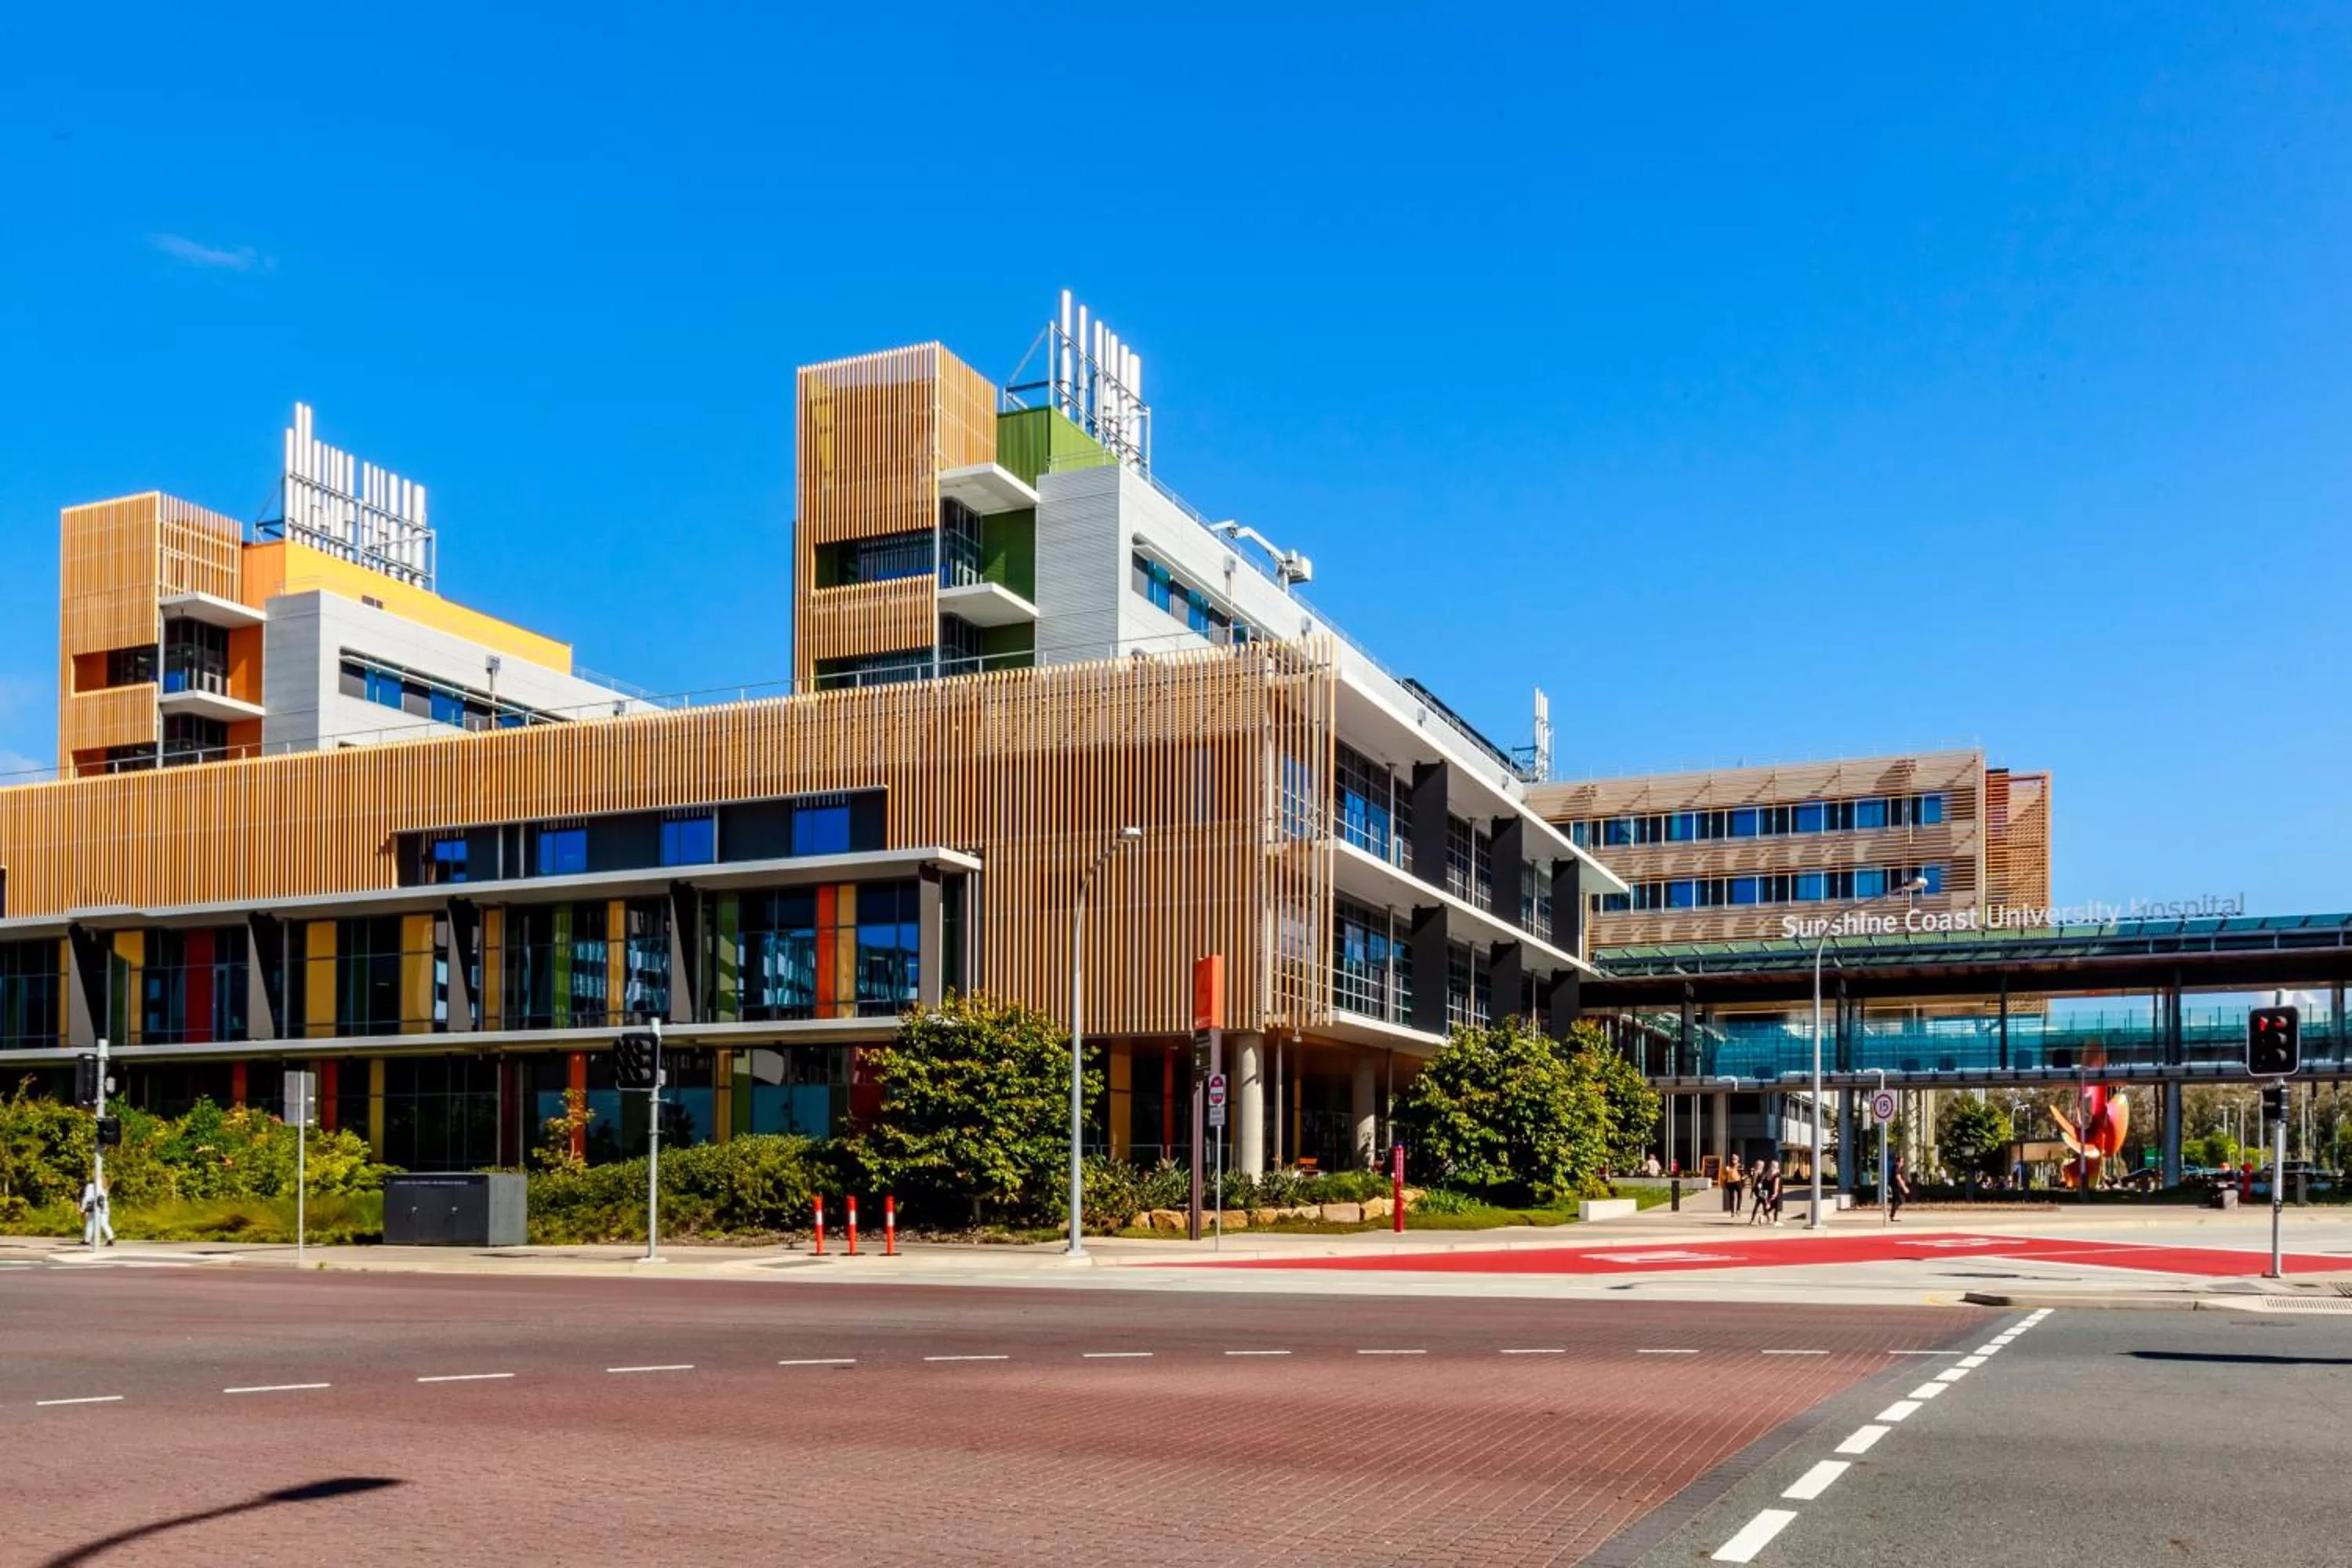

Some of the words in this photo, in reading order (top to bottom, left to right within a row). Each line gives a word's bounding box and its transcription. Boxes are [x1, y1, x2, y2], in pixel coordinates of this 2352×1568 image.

[1782, 911, 1898, 938] Sunshine
[1905, 908, 1980, 931] Coast
[1987, 900, 2122, 928] University
[2129, 891, 2245, 919] Hospital
[1879, 1100, 1889, 1112] 15
